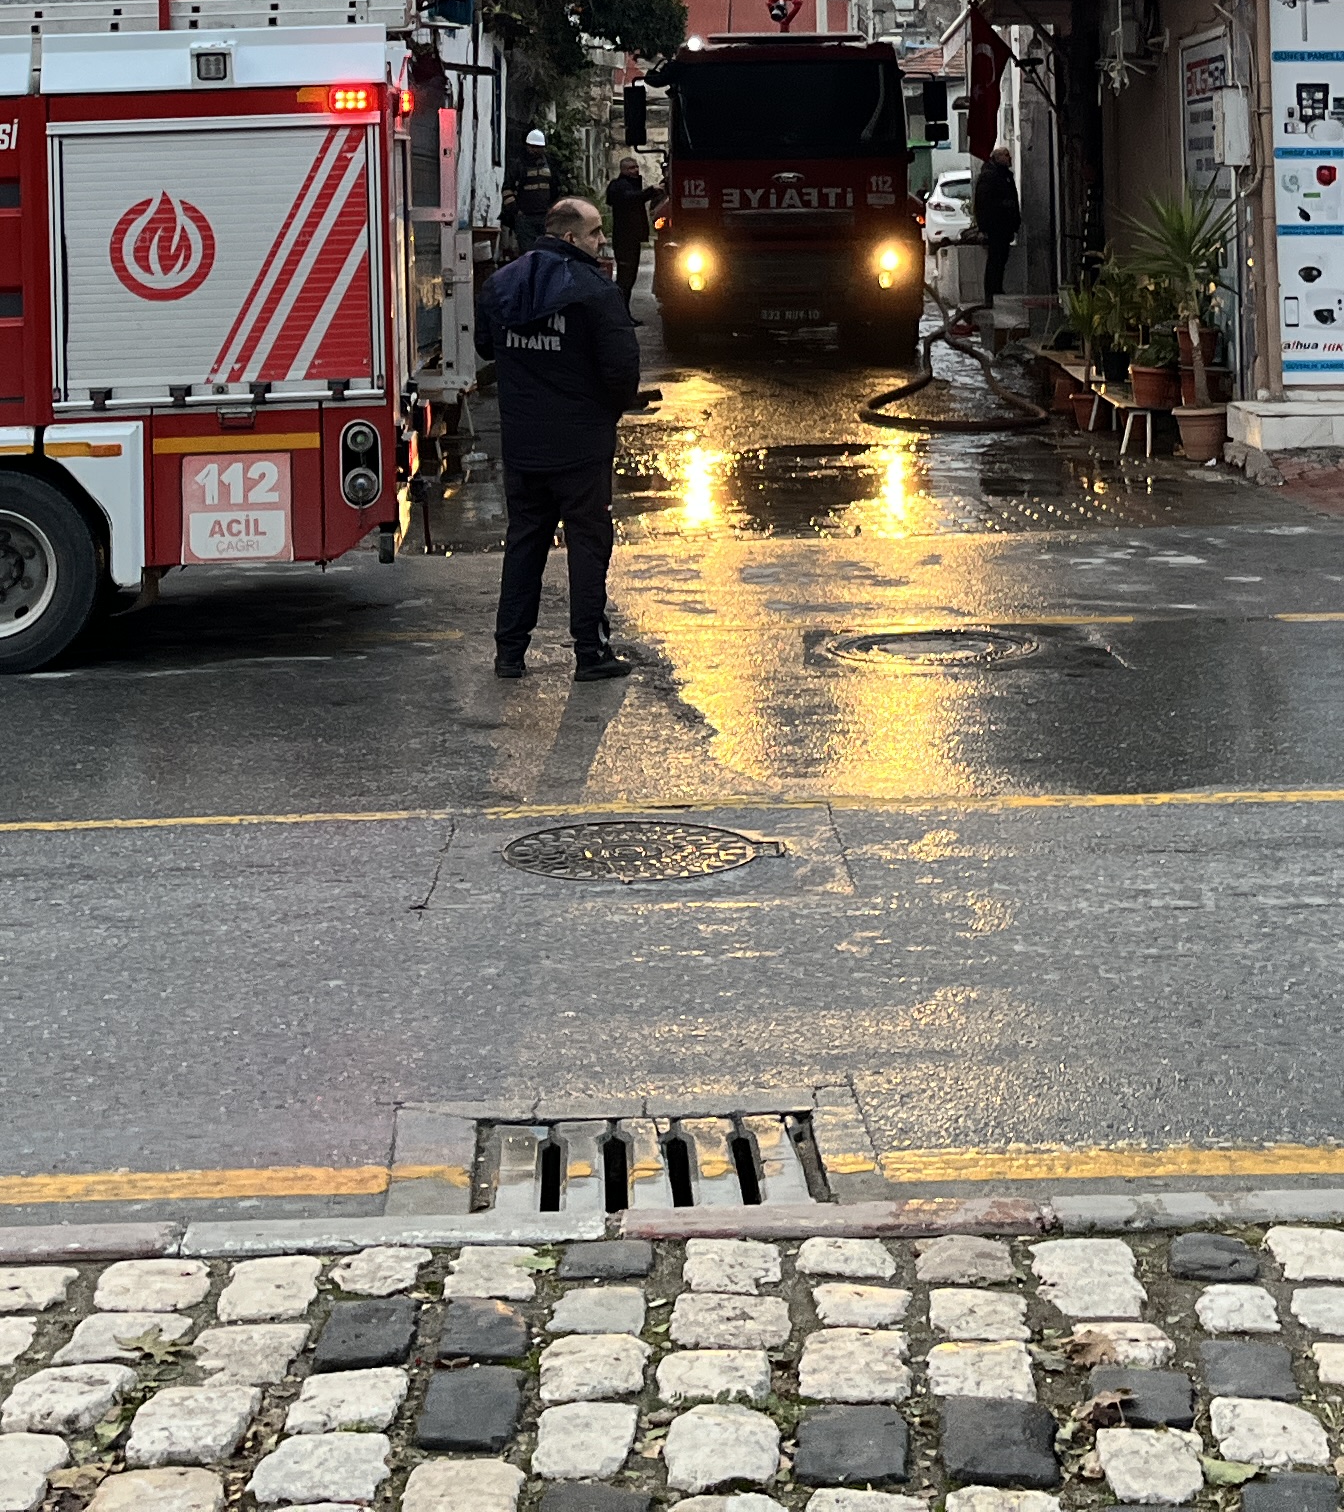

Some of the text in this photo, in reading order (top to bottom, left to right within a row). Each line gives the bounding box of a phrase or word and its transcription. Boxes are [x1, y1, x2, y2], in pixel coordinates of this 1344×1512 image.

[683, 179, 705, 196] 112
[869, 175, 893, 192] 112
[194, 460, 280, 505] 112
[208, 513, 268, 538] ACİL
[216, 538, 260, 556] ÇAĞRI
